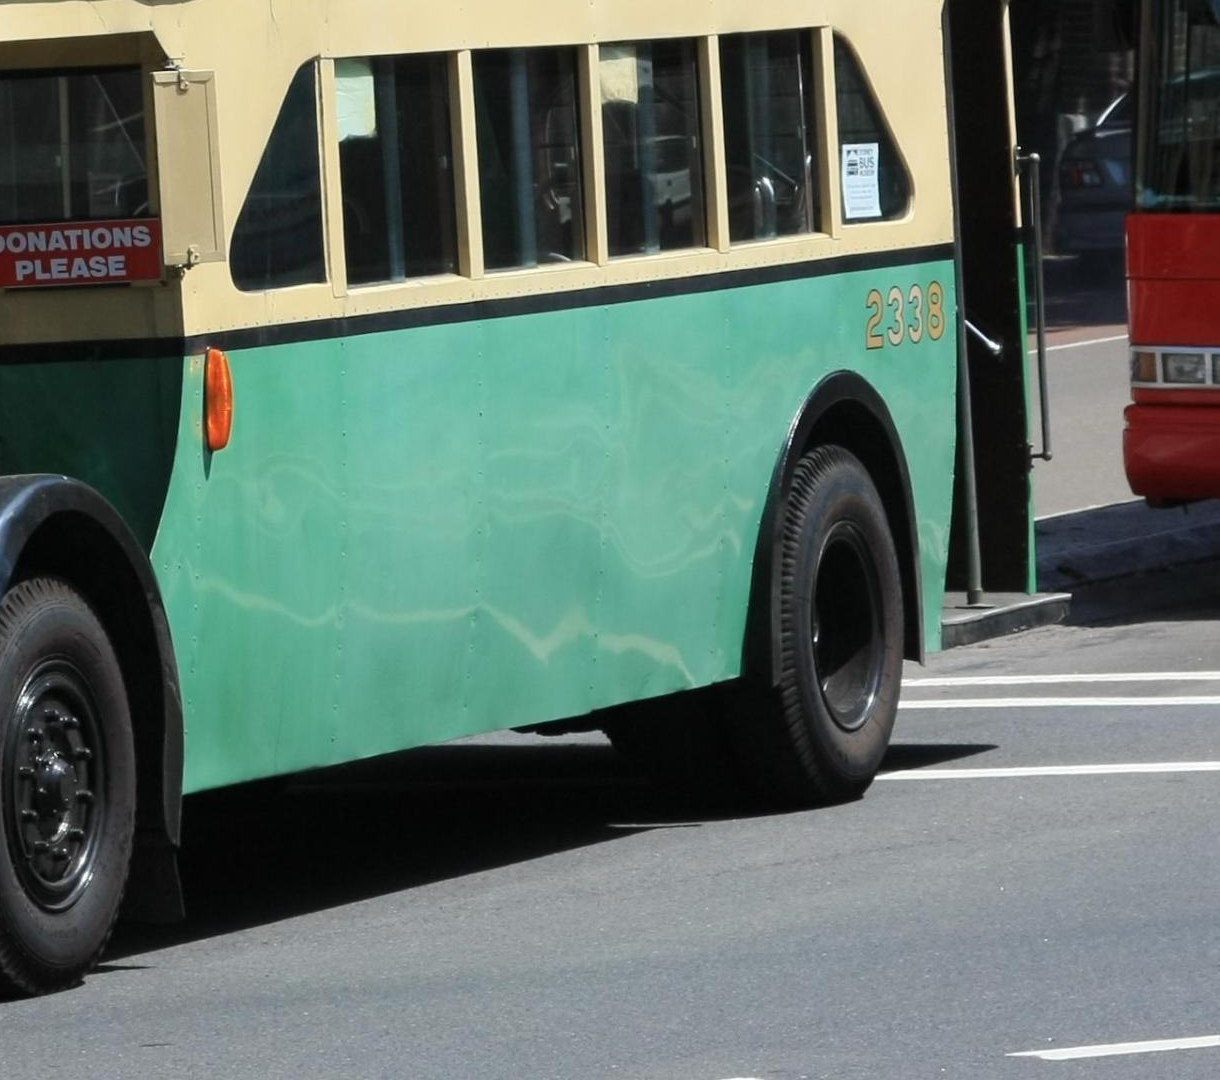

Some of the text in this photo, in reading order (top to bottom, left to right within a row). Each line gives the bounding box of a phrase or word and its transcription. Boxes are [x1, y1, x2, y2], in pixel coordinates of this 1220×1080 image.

[860, 157, 875, 169] BUS
[15, 255, 127, 281] PLEASE
[865, 280, 945, 350] 2338
